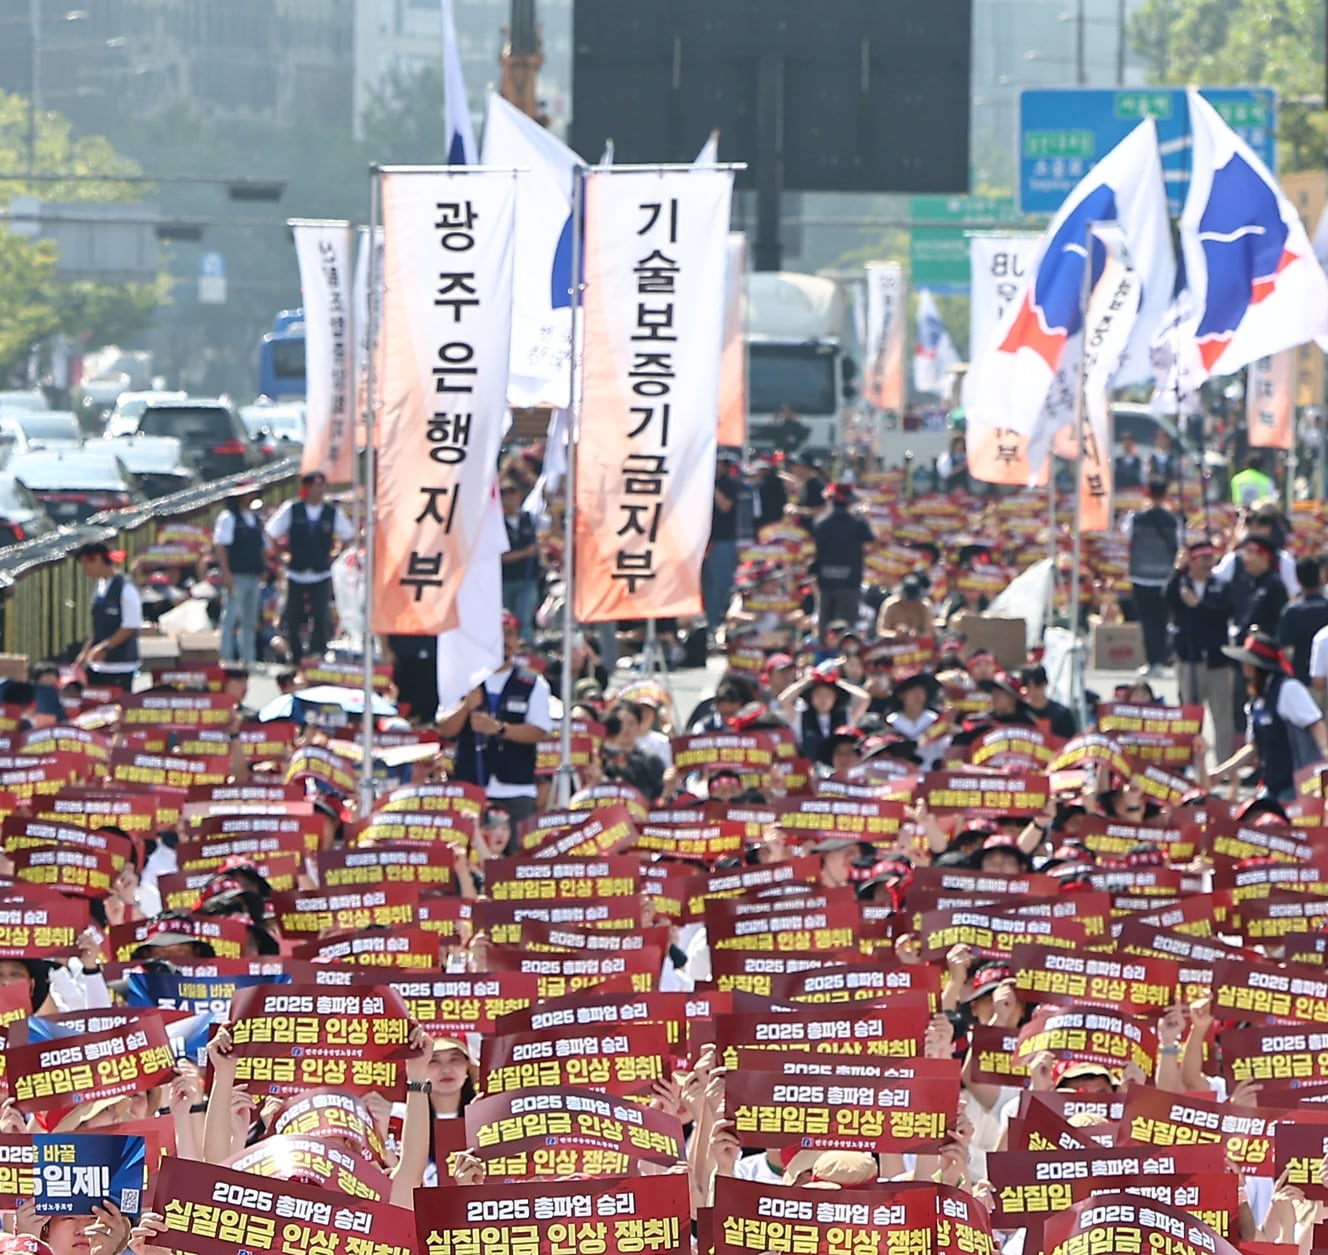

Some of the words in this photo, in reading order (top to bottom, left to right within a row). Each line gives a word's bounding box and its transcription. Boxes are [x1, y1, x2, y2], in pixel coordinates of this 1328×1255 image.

[400, 200, 479, 601] 광주은행지부
[611, 198, 681, 595] 기술보증기금지부
[264, 996, 313, 1012] 2025
[316, 994, 359, 1014] 총파업
[362, 996, 384, 1014] 승리
[230, 1015, 319, 1044] 실질임금
[324, 1016, 369, 1044] 인상
[372, 1015, 411, 1044] 쟁취!
[40, 1045, 82, 1067] 2025
[83, 1036, 125, 1060] 총파업
[124, 1030, 148, 1050] 승리
[14, 1064, 94, 1100] 실질임금
[97, 1054, 138, 1085] 인상
[139, 1042, 180, 1073] 쟁취!
[772, 1084, 824, 1109] 2025
[826, 1086, 874, 1105] 총파업
[877, 1088, 909, 1107] 승리
[730, 1105, 830, 1141] 실질임금
[835, 1108, 885, 1142] 인상
[889, 1110, 949, 1138] 쟁취!
